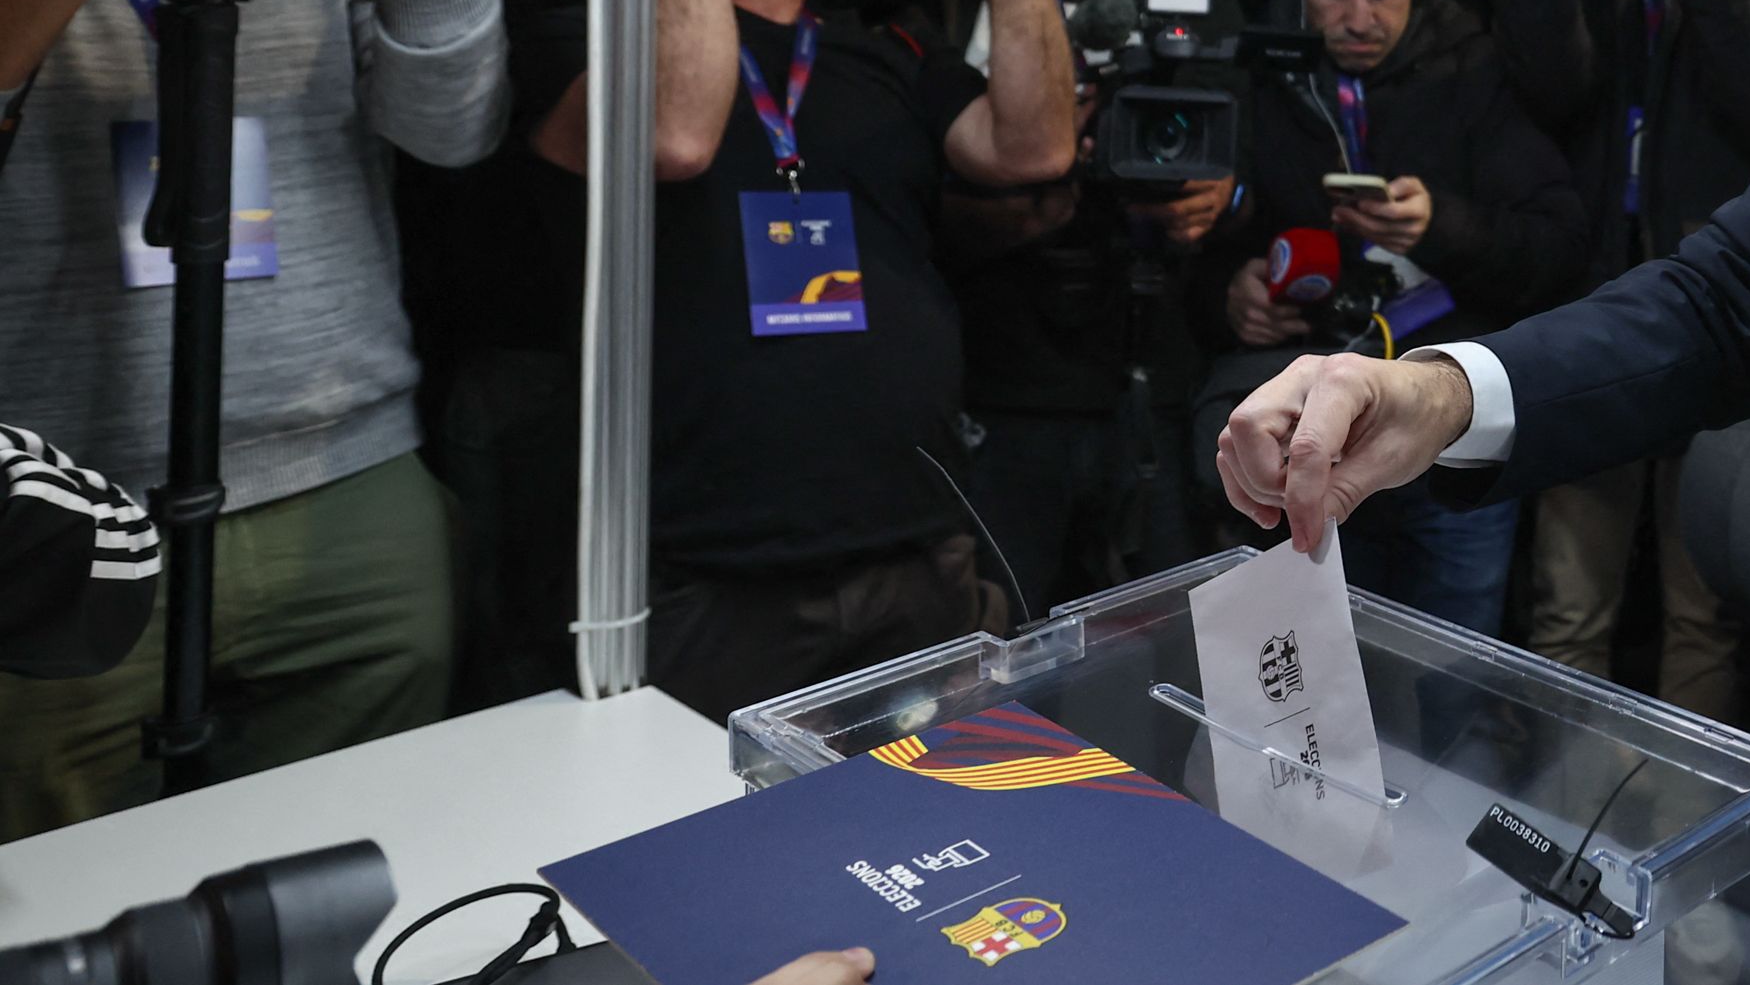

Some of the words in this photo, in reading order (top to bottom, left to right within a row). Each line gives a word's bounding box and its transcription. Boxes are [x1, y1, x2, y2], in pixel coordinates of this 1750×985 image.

[1304, 723, 1325, 801] ELECCNS
[1489, 805, 1551, 854] PL0038310
[845, 860, 922, 913] ELECCIONS
[884, 864, 925, 890] 2026
